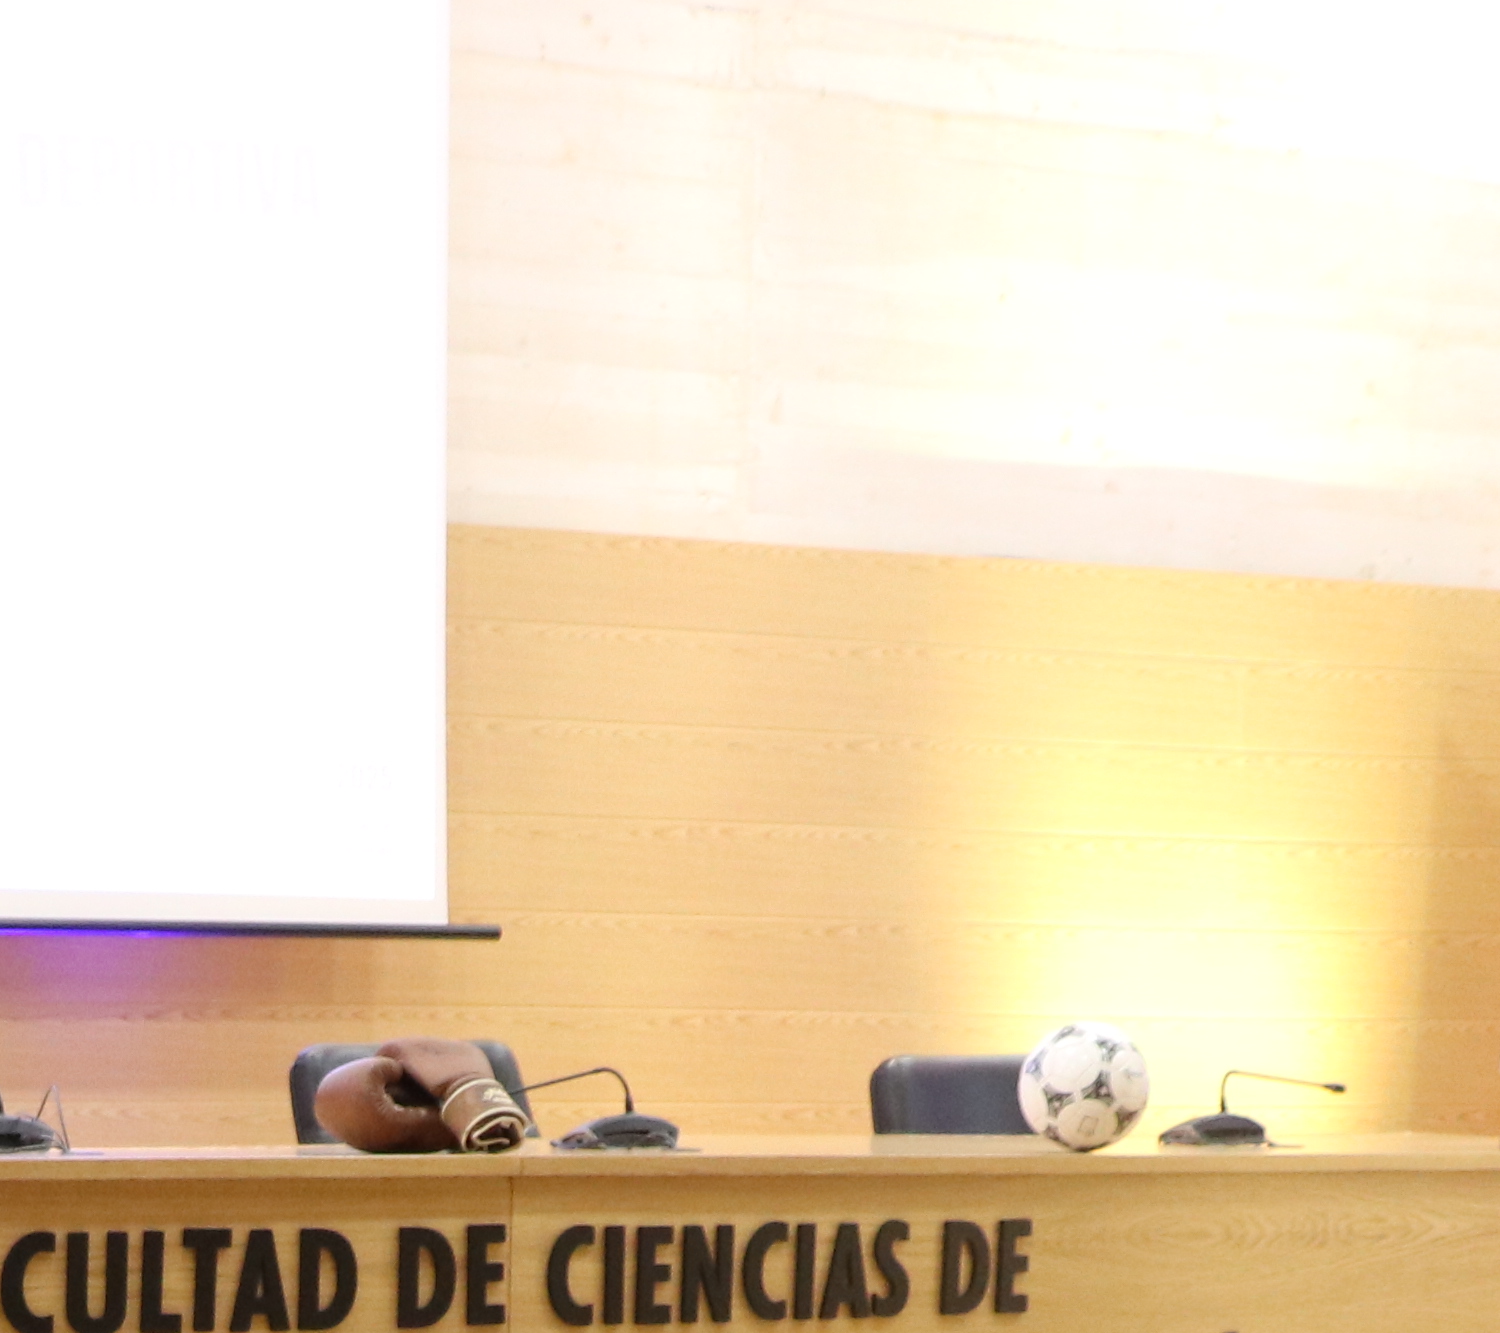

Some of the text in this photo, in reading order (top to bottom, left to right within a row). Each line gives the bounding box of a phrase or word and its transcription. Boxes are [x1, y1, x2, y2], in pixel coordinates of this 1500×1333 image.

[397, 1223, 507, 1330] DE
[547, 1220, 911, 1326] CIENCIAS
[939, 1218, 1033, 1316] DE
